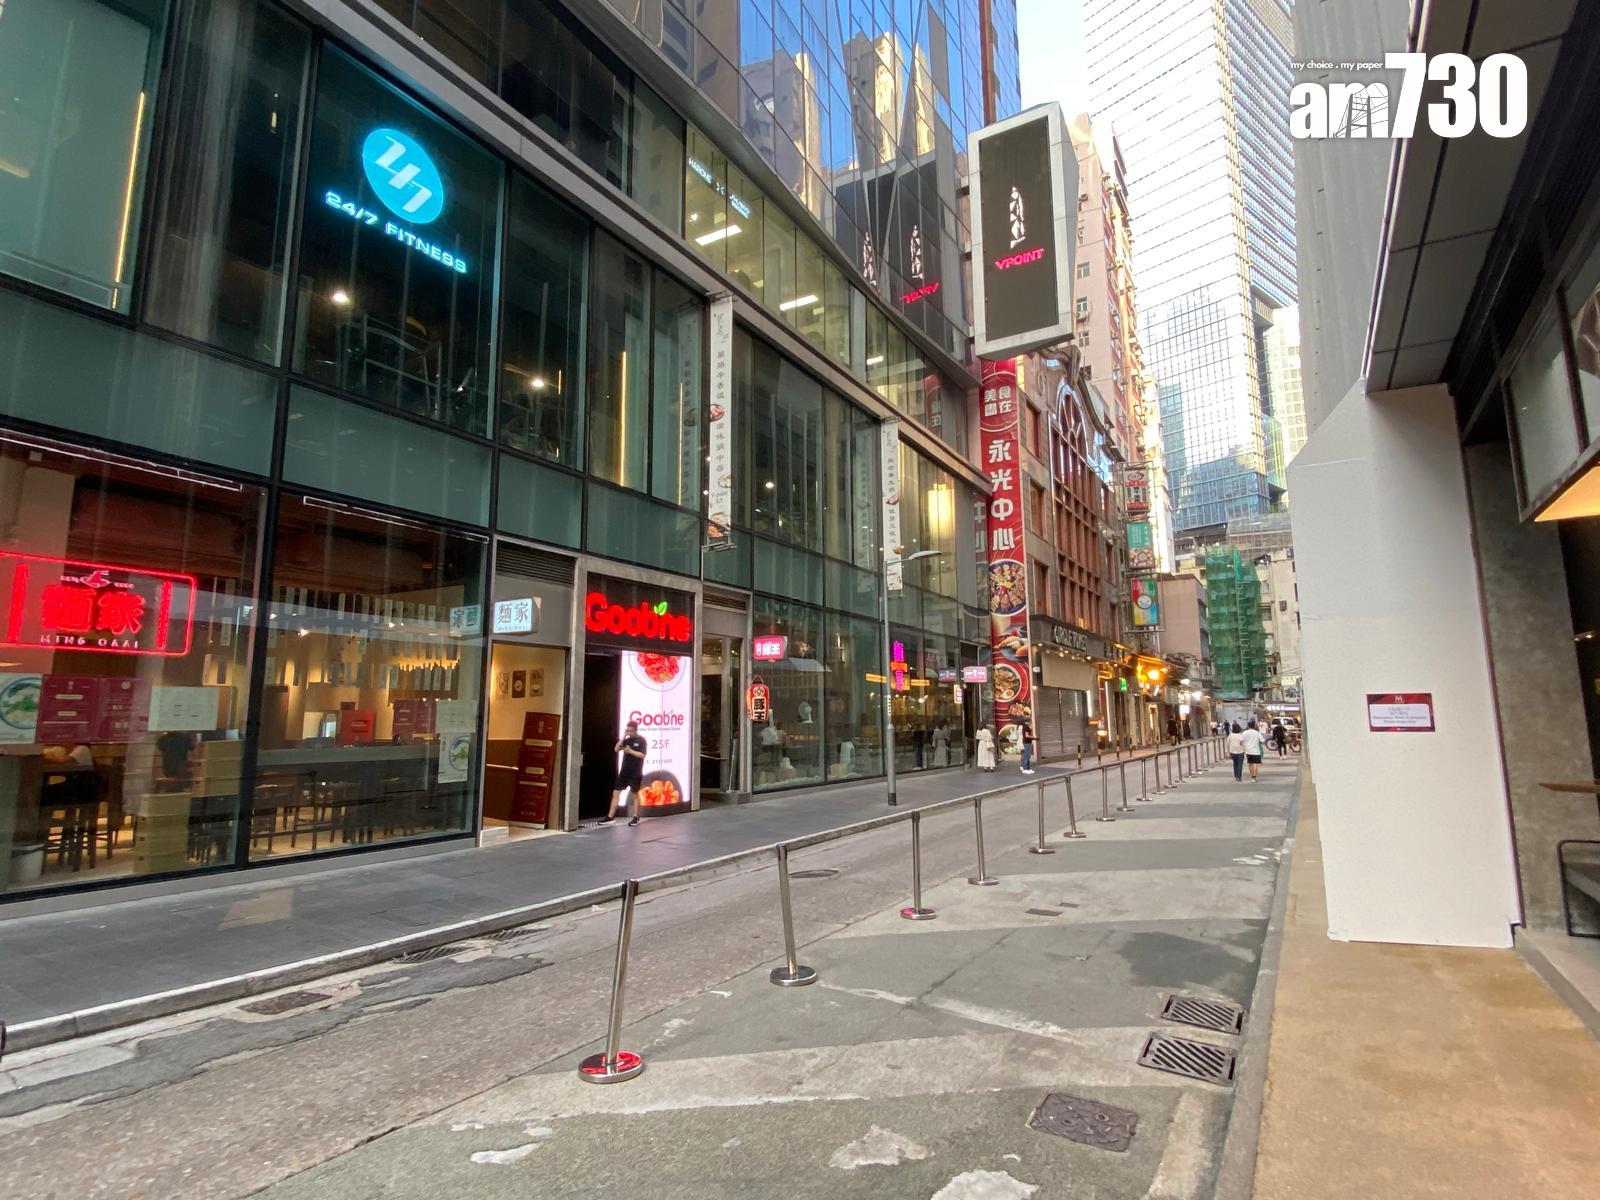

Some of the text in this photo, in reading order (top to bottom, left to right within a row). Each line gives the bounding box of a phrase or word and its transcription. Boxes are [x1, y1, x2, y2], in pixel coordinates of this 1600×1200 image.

[326, 191, 467, 273] 24/7 FITNESS
[995, 248, 1044, 269] VPOINT
[989, 440, 1015, 550] 永光中心
[585, 592, 691, 642] Goobne
[629, 710, 684, 726] Goobne
